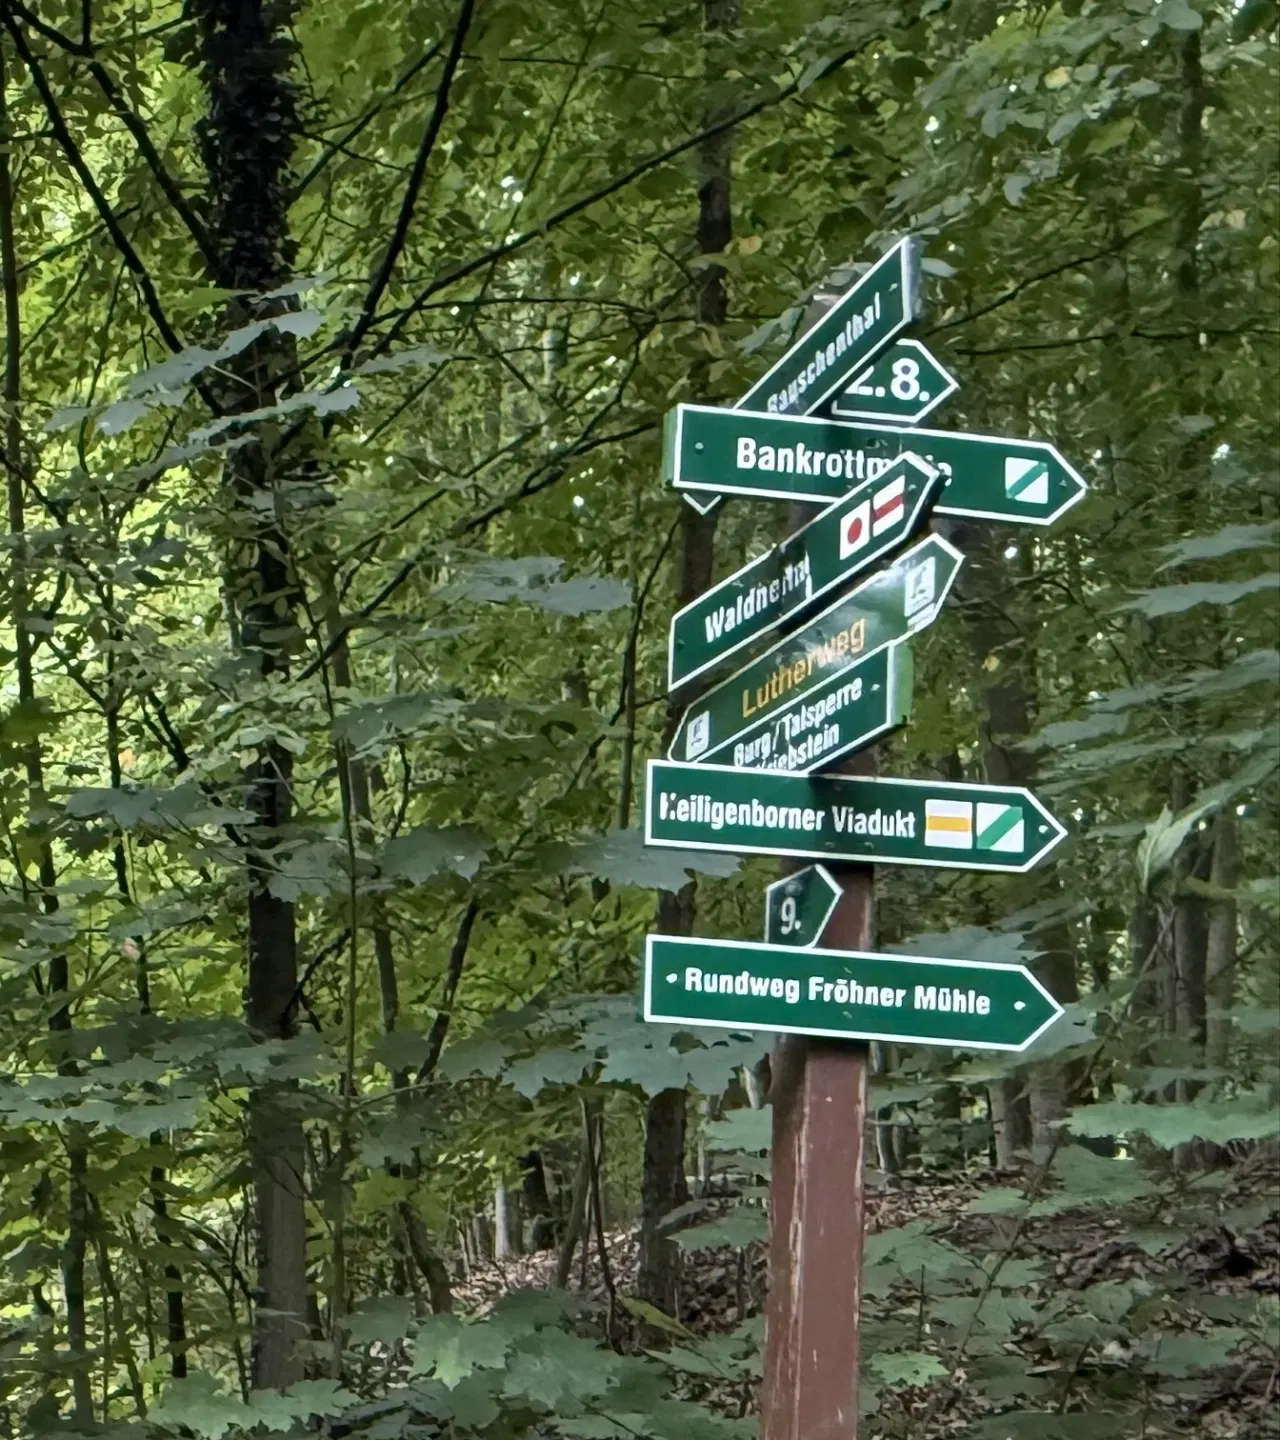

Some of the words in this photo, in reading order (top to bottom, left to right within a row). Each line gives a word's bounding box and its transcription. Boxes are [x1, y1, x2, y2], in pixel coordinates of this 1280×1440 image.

[742, 617, 866, 718] Lutherweg
[831, 804, 916, 838] Viadukt
[780, 896, 802, 935] 9.
[684, 966, 800, 1005] Rundweg
[807, 975, 907, 1009] Fröhner
[913, 985, 991, 1015] Mühle
